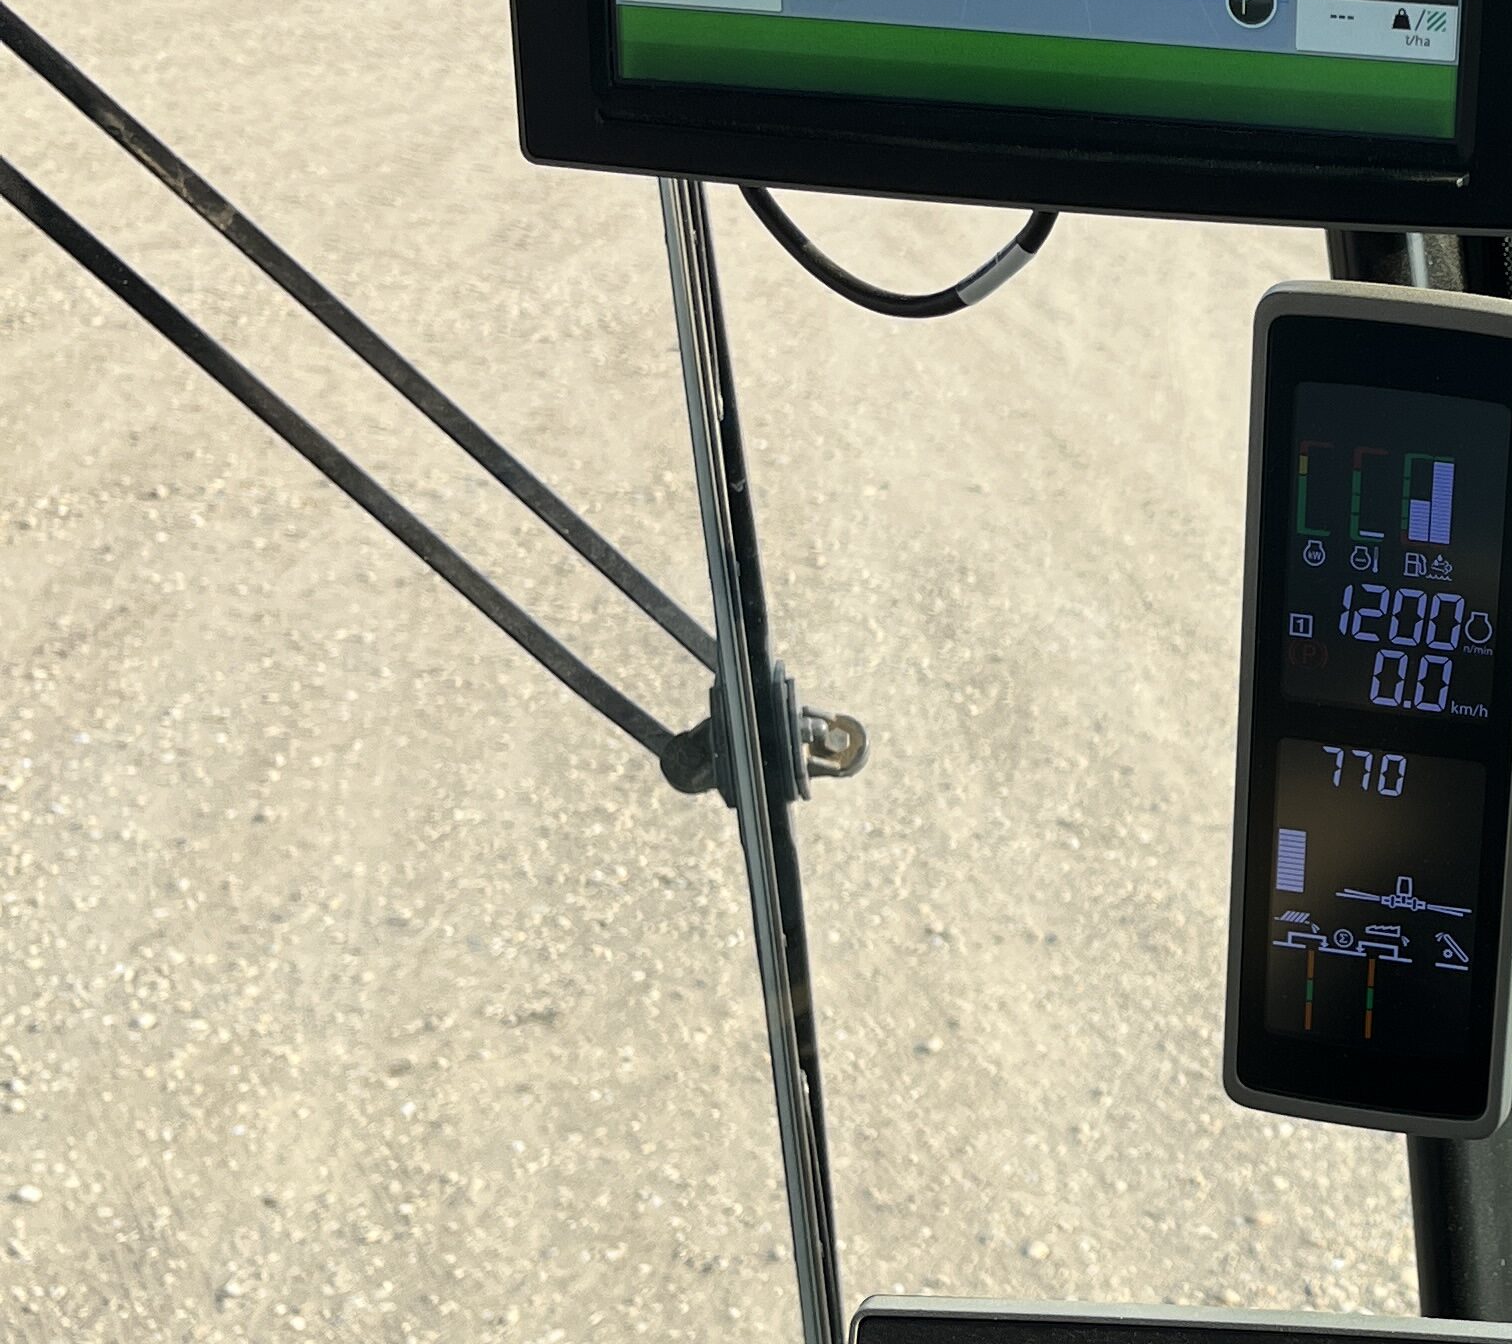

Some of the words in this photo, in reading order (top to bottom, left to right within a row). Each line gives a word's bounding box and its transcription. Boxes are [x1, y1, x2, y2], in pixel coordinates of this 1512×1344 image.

[1405, 33, 1432, 49] t/ha
[1338, 583, 1465, 652] 1200
[1463, 643, 1493, 657] n/min
[1369, 648, 1453, 713] 0.0
[1450, 701, 1489, 719] km/h
[1322, 745, 1407, 798] 770
